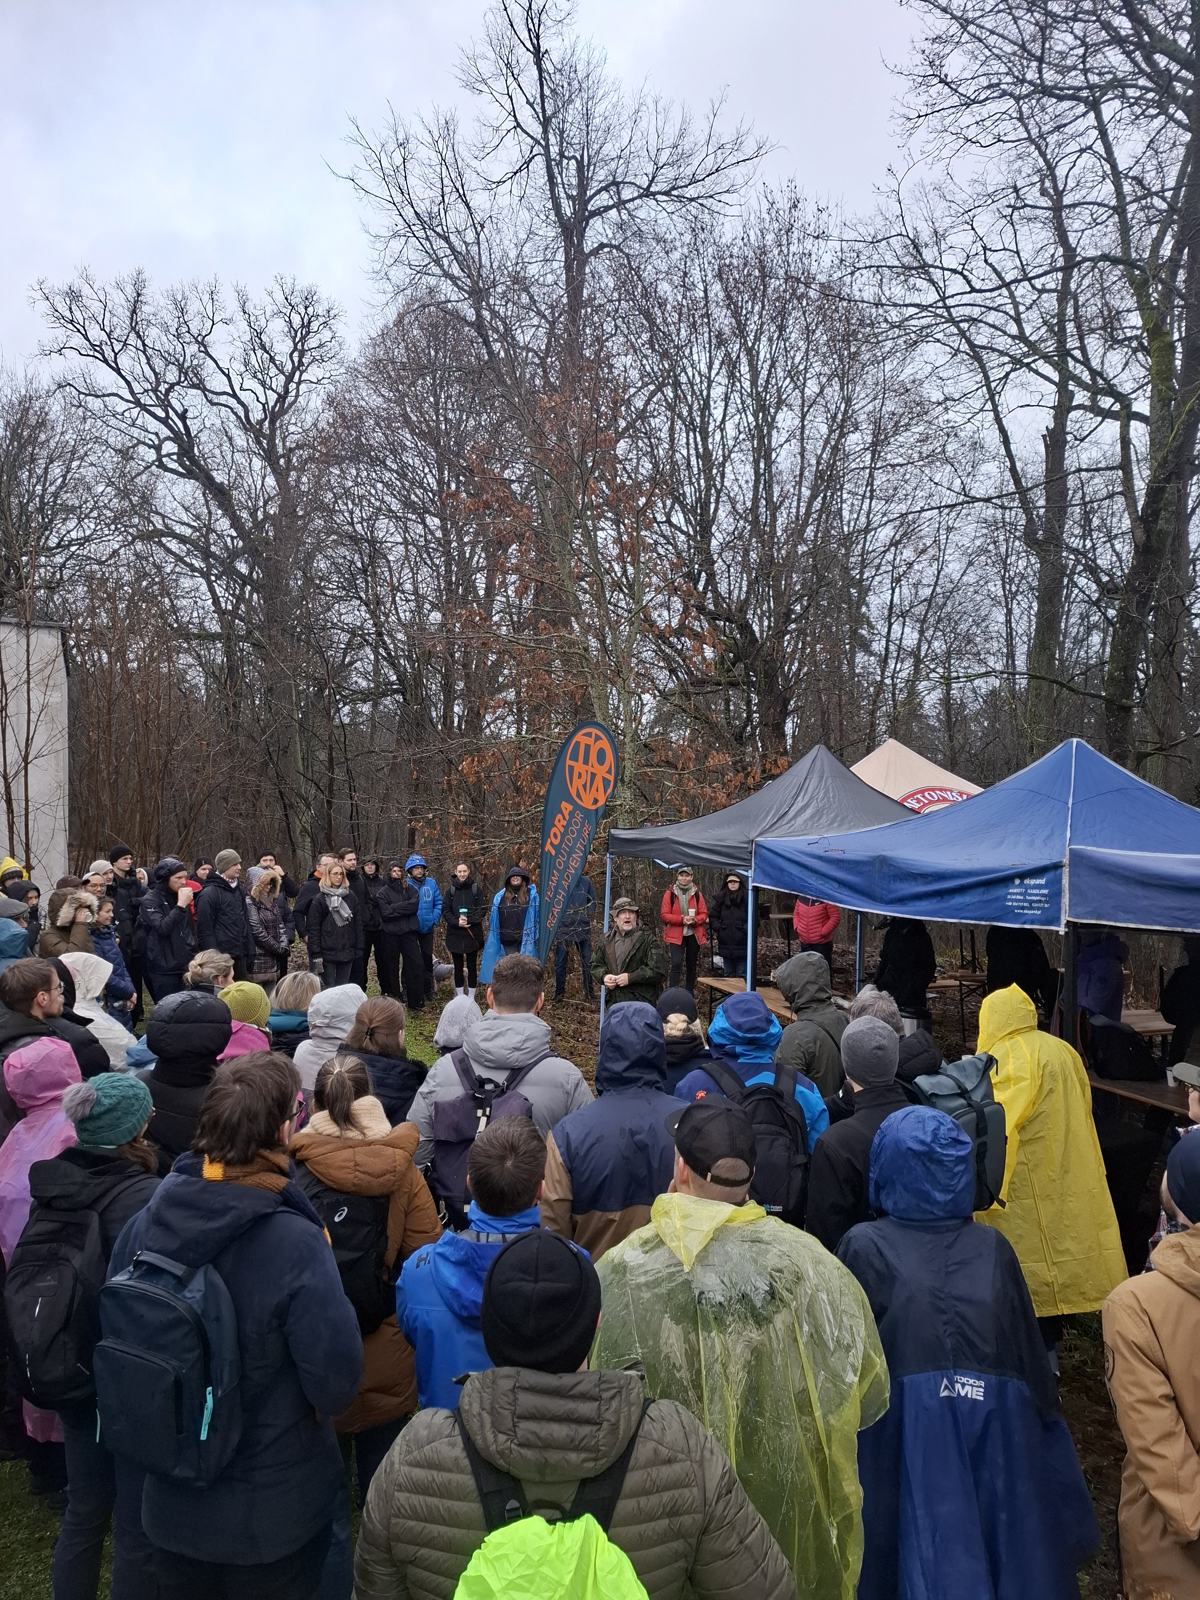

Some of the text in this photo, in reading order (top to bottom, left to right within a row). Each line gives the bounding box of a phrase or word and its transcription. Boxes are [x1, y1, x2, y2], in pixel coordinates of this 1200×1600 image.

[544, 801, 573, 855] TORA
[545, 810, 584, 902] TEAM OUTDOOR
[546, 820, 592, 931] REACH ADVENTURE
